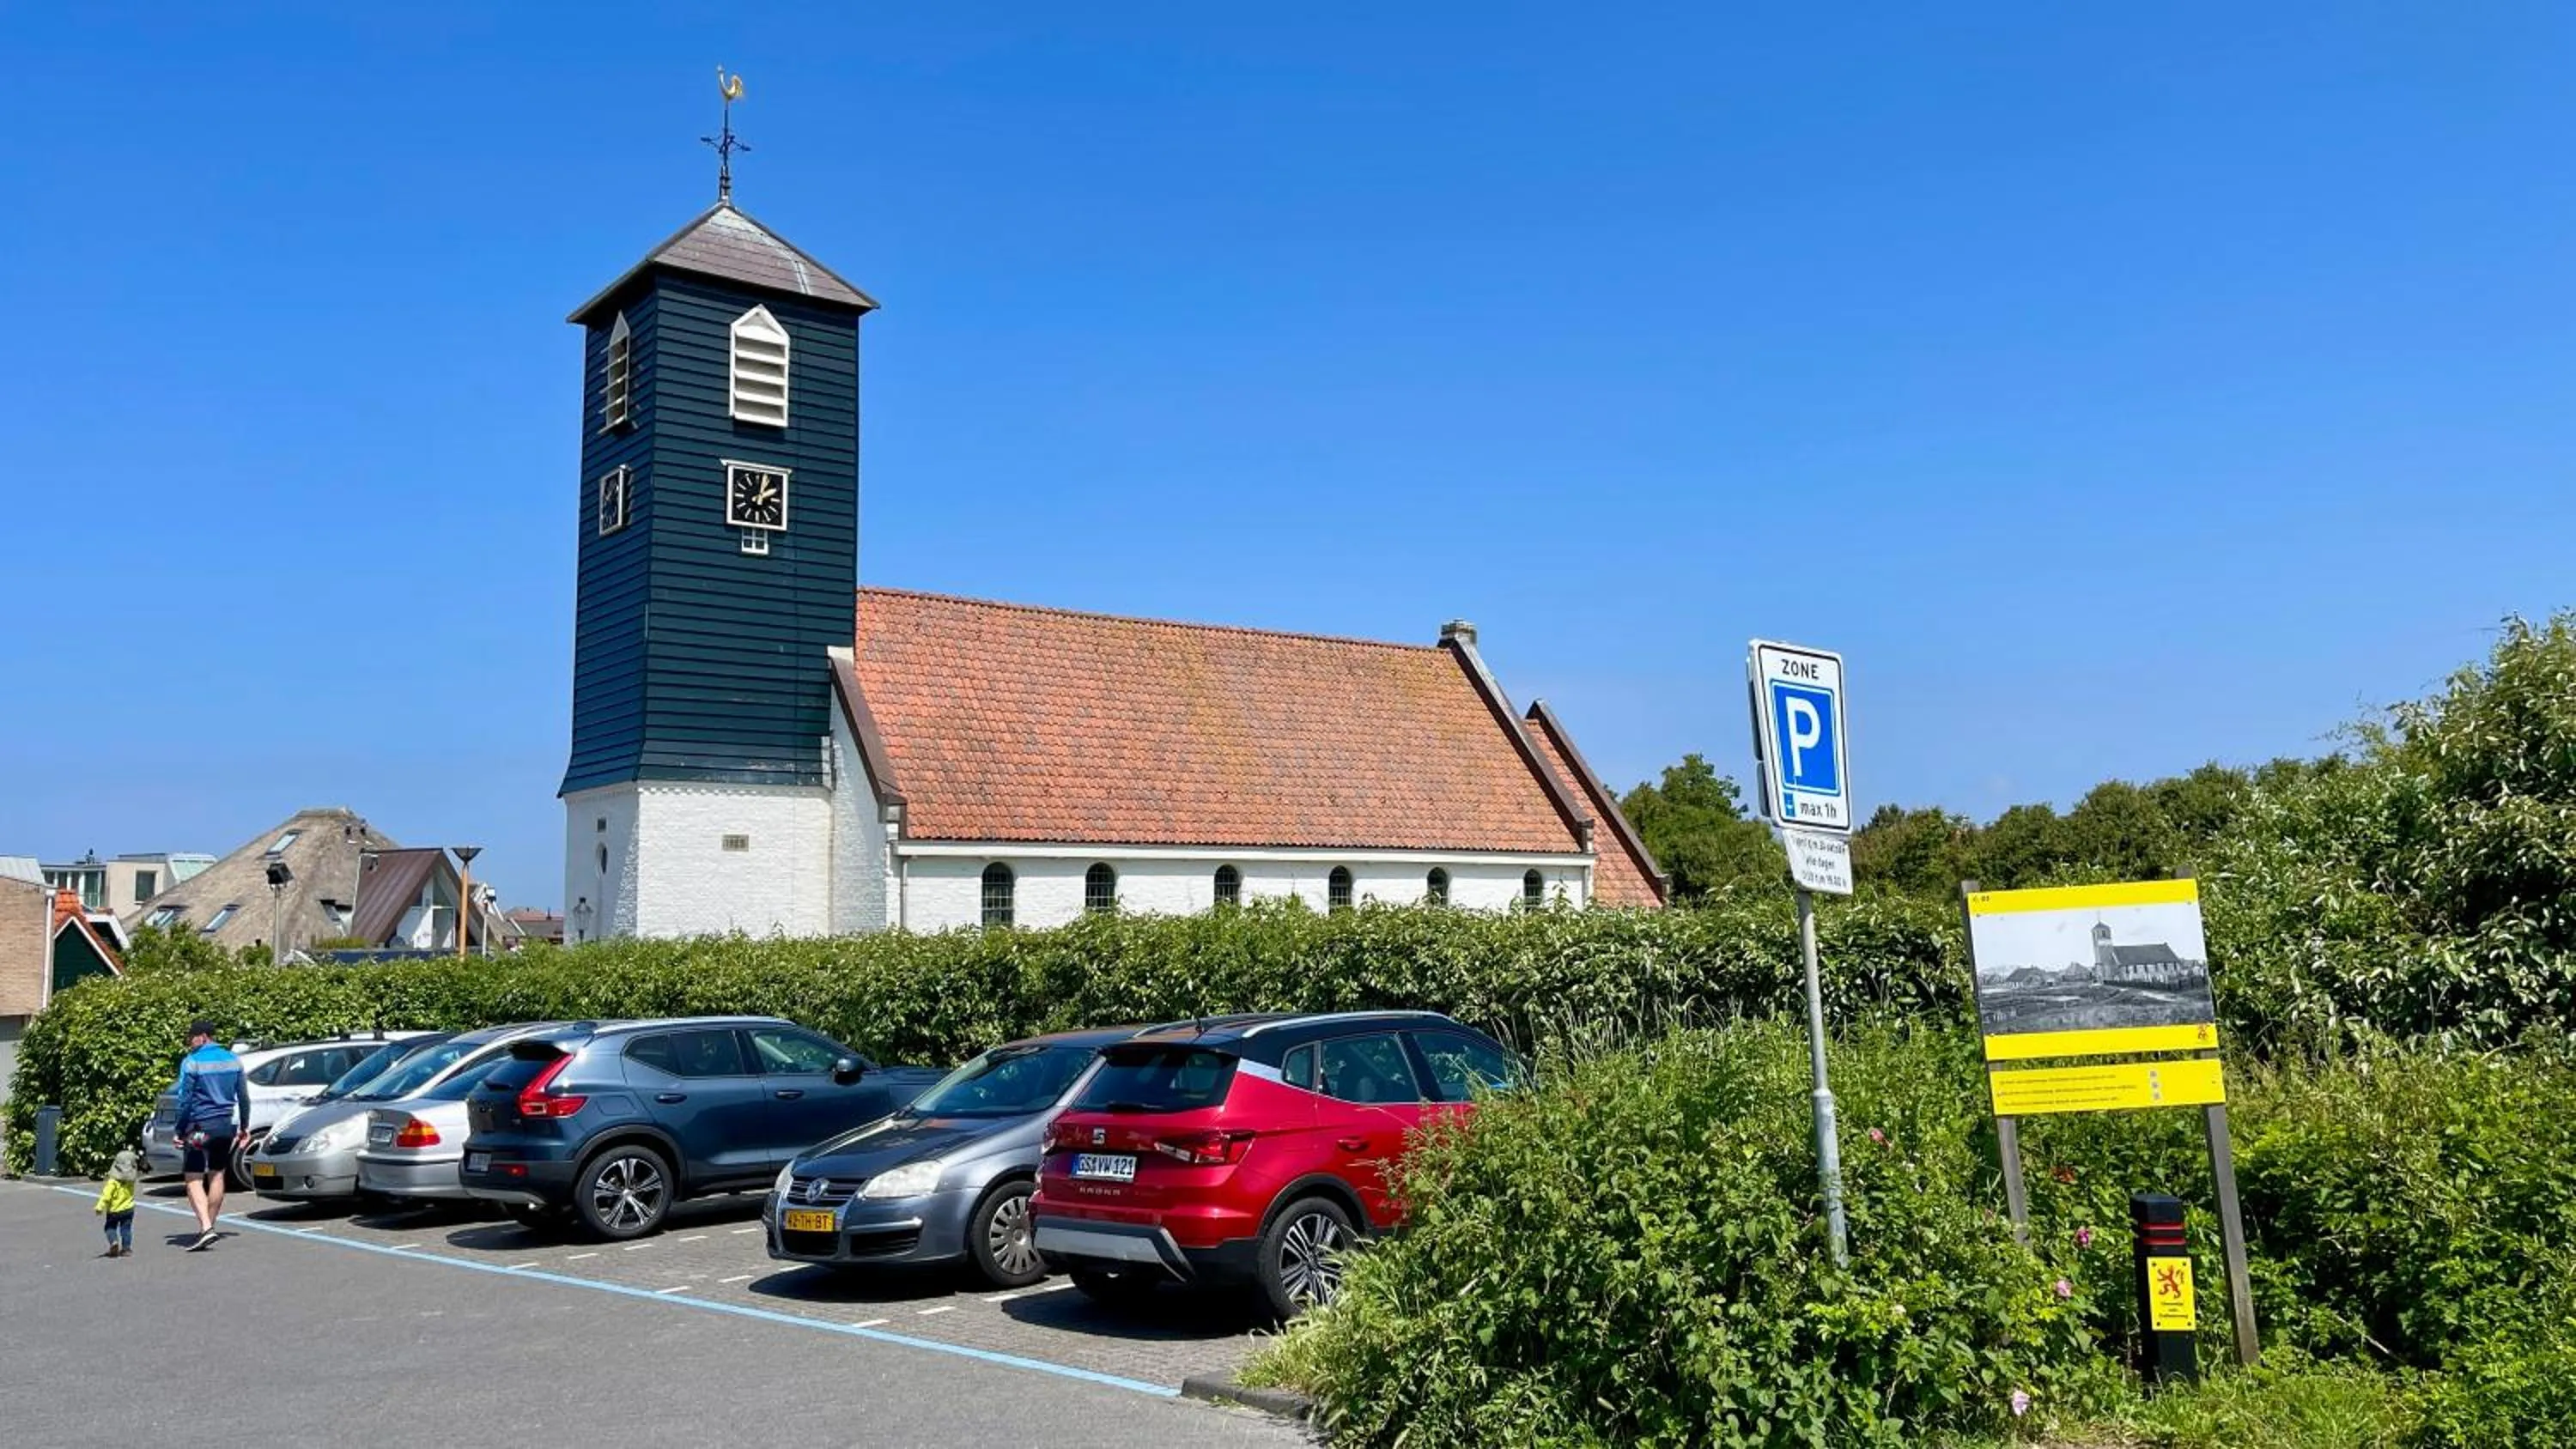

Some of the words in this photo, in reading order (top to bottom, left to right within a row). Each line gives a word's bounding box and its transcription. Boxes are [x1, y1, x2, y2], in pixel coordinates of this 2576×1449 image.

[1781, 658, 1820, 680] ZONE
[1785, 696, 1821, 777] P
[1800, 803, 1823, 817] max
[1825, 803, 1837, 818] 1h
